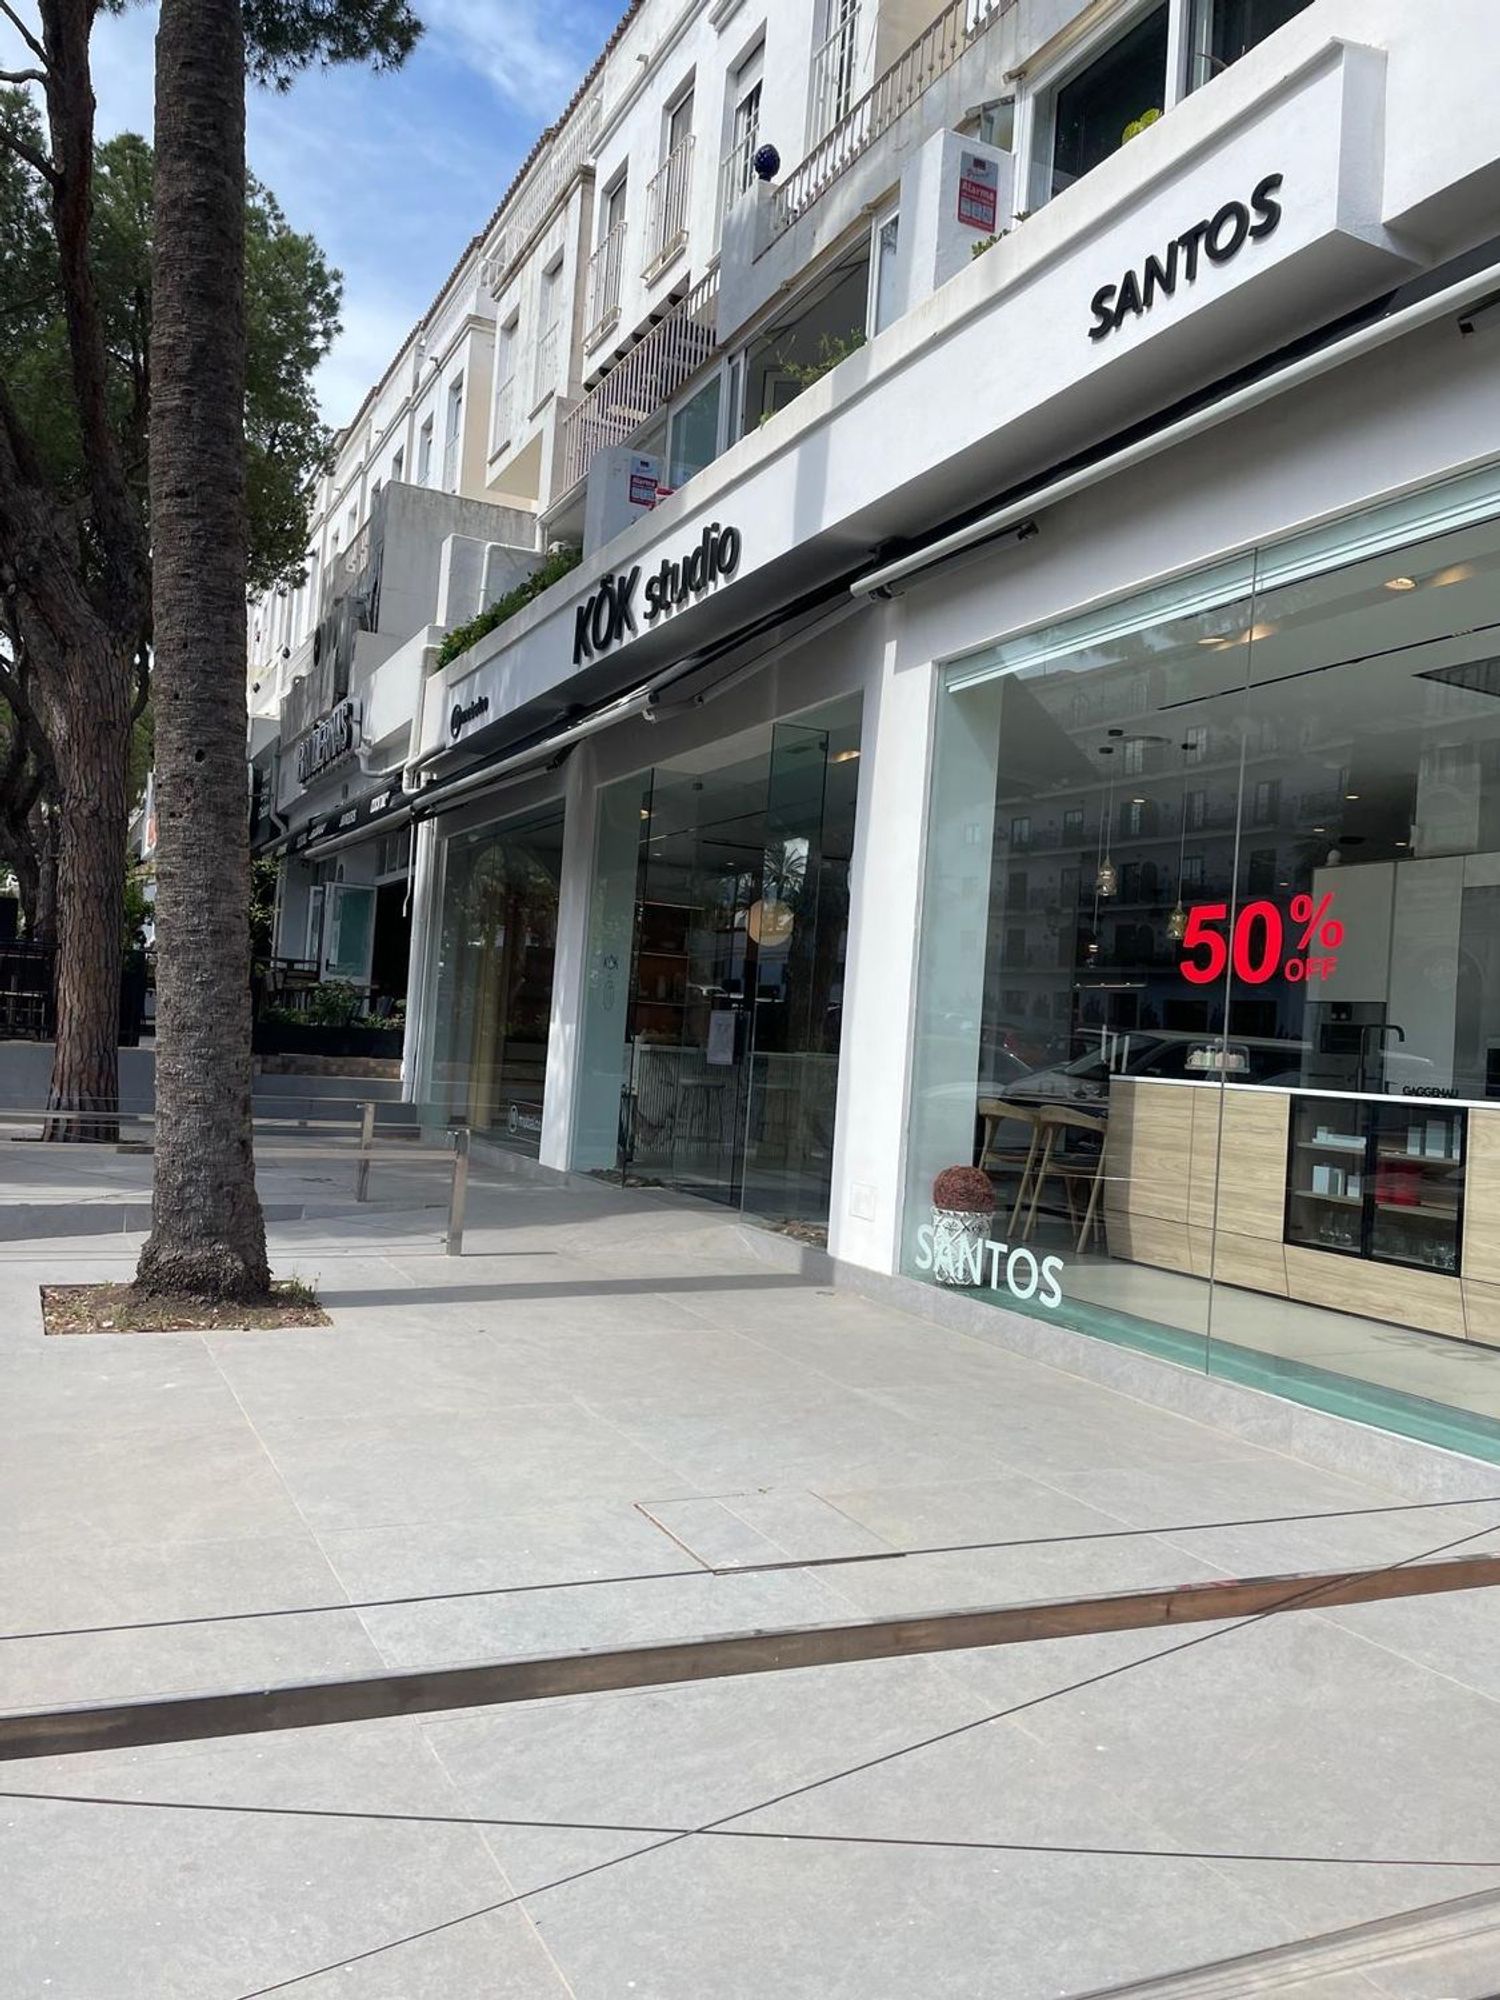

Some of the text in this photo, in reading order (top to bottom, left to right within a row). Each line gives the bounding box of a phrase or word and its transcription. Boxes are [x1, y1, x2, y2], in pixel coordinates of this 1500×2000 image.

[1088, 173, 1284, 338] SANTOS
[573, 522, 741, 664] KÖK studio
[1180, 892, 1345, 984] 50%
[1284, 956, 1338, 982] OFF
[915, 1223, 1064, 1308] SANTOS
